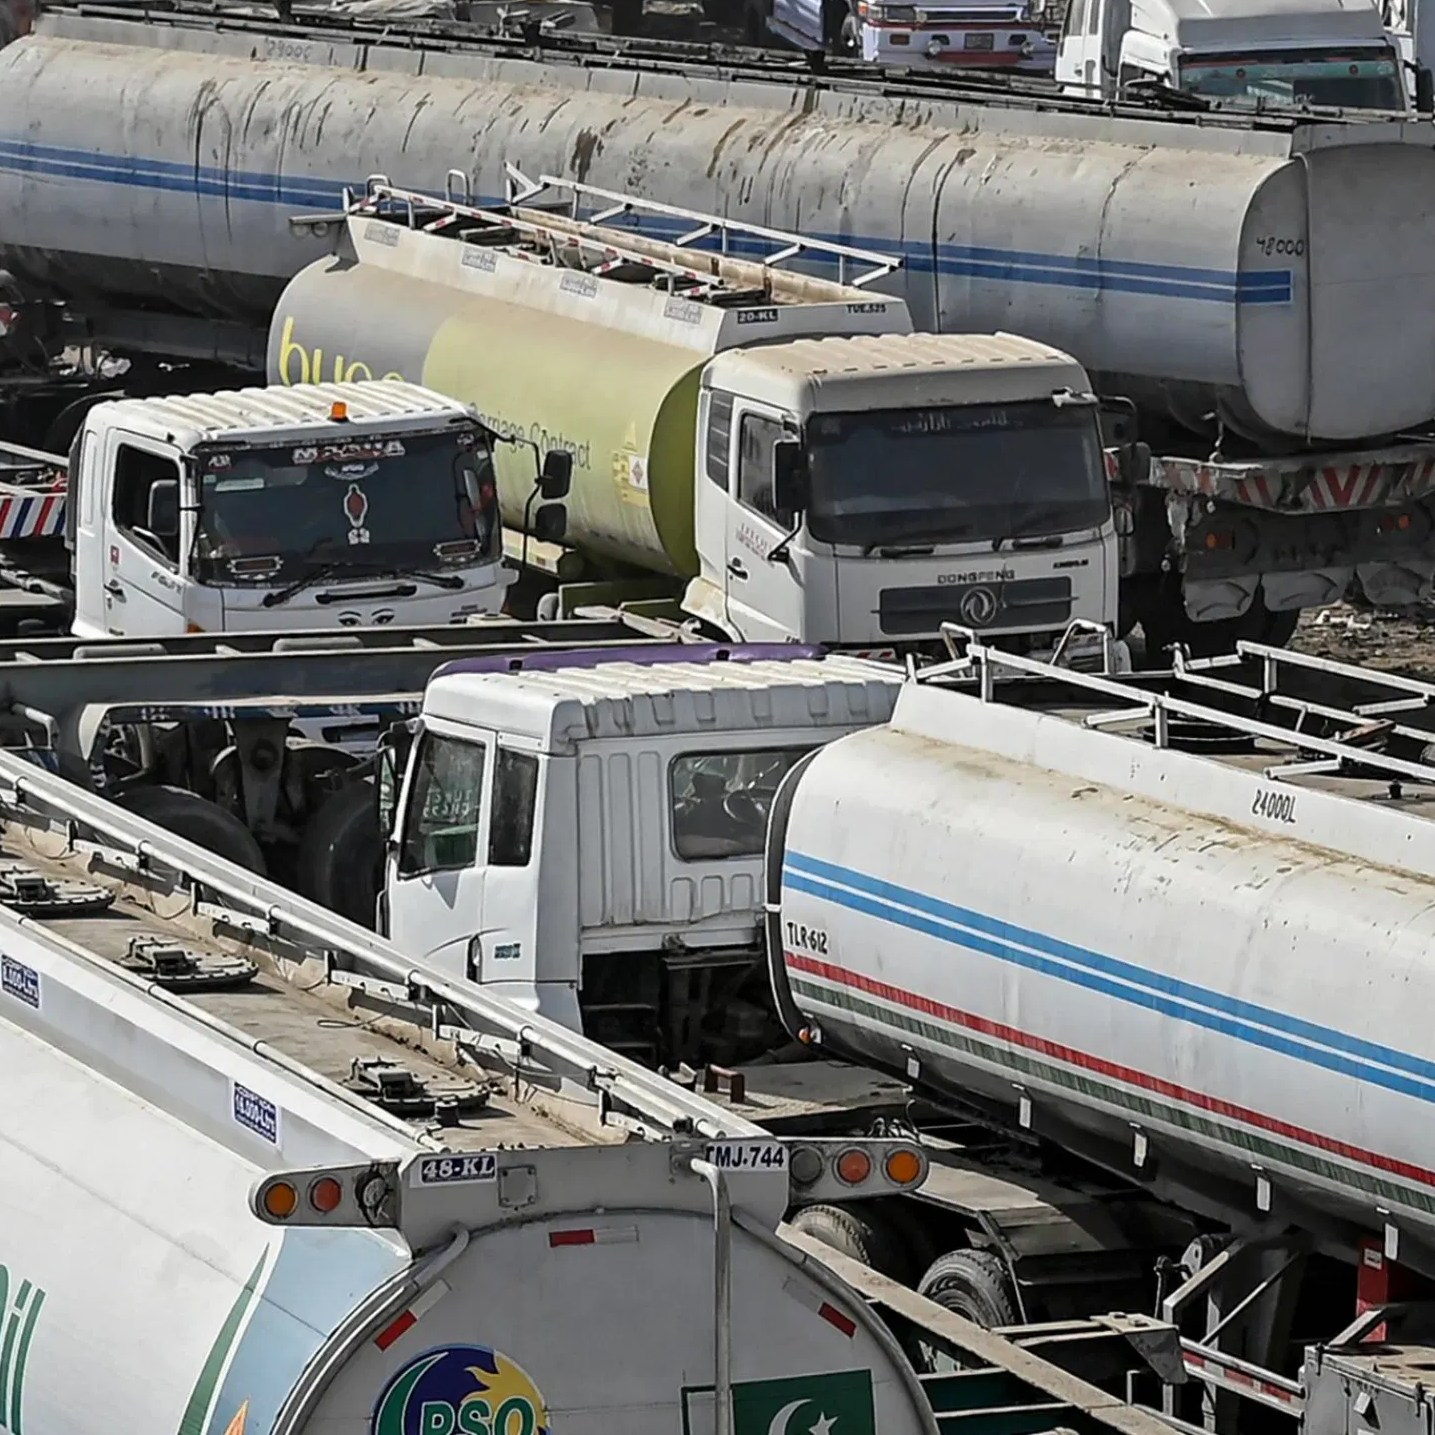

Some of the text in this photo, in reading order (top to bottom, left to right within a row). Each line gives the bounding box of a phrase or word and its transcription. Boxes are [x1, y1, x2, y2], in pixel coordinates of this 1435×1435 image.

[1256, 236, 1305, 257] 48000
[937, 569, 1016, 584] DONGFENG
[422, 1156, 496, 1180] 48-KL
